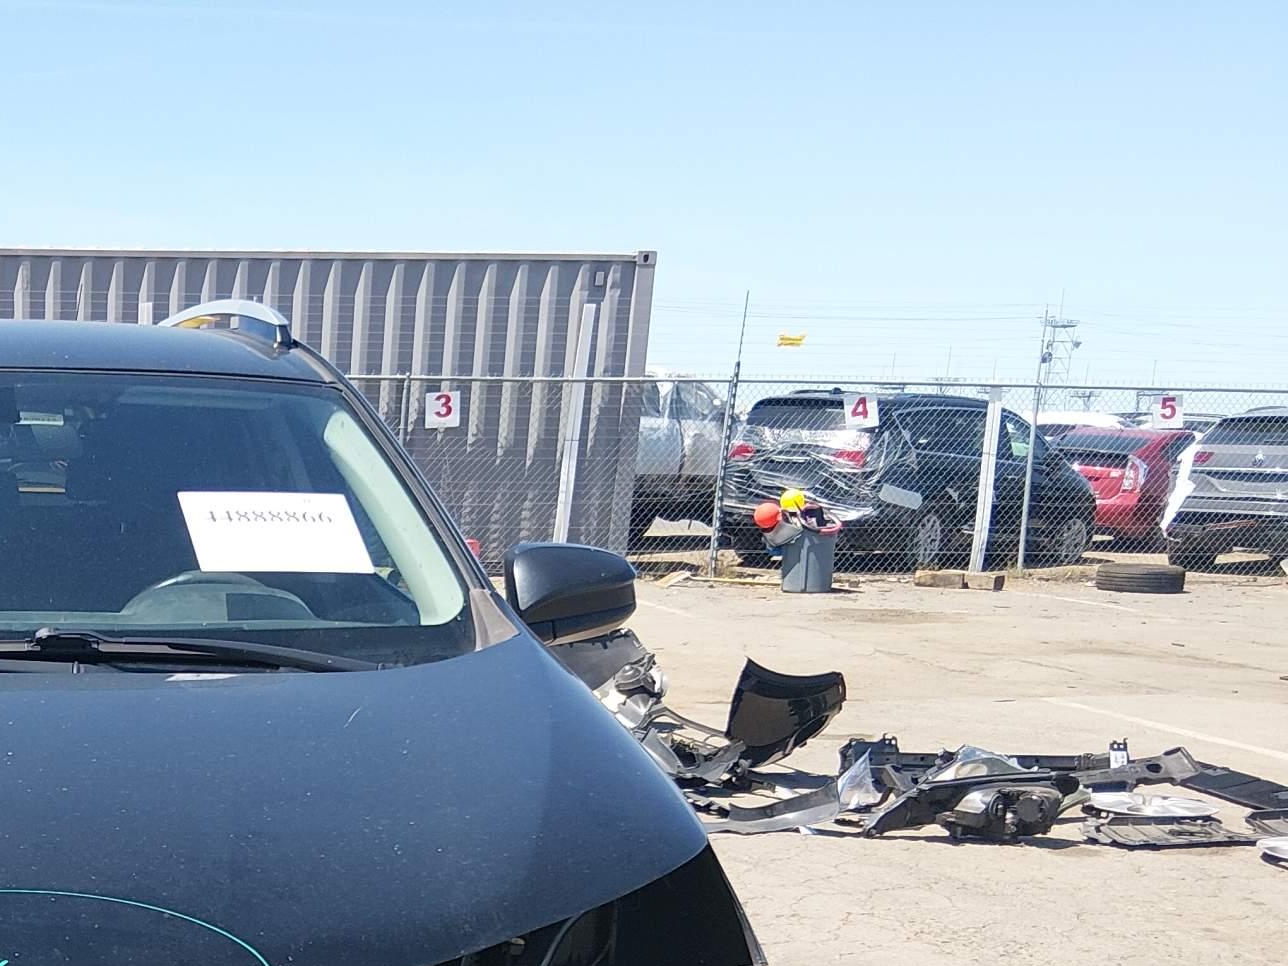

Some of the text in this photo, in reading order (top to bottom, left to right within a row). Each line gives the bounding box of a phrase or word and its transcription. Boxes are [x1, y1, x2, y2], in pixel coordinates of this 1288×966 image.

[434, 394, 453, 419] 3
[851, 396, 868, 419] 4
[1159, 396, 1177, 420] 5
